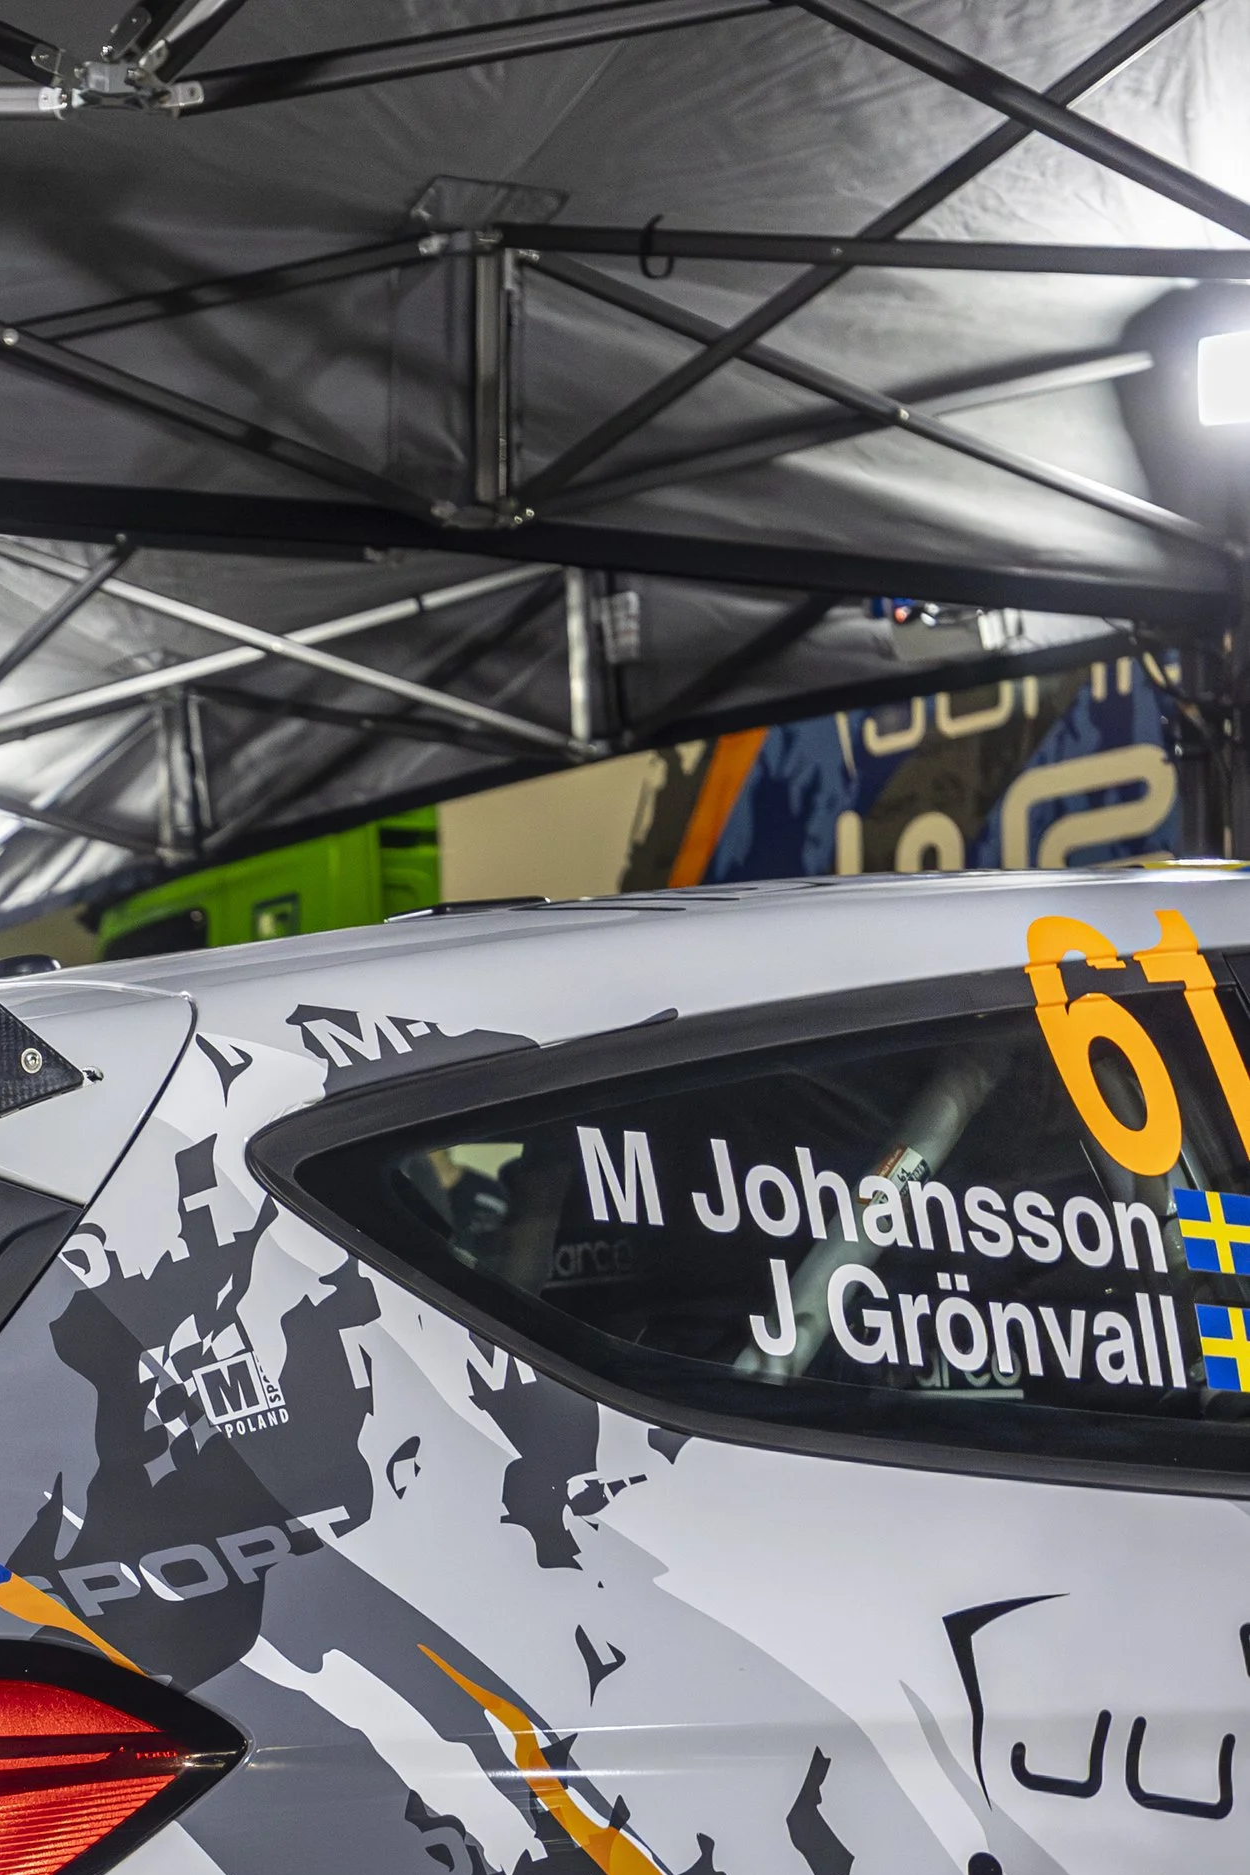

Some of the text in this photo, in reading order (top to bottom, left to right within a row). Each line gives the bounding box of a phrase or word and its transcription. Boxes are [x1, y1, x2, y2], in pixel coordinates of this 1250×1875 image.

[1026, 908, 1250, 1177] 61
[576, 1125, 1168, 1274] M Johansson
[748, 1257, 1188, 1390] J Grönvall
[224, 1408, 290, 1439] POLAND
